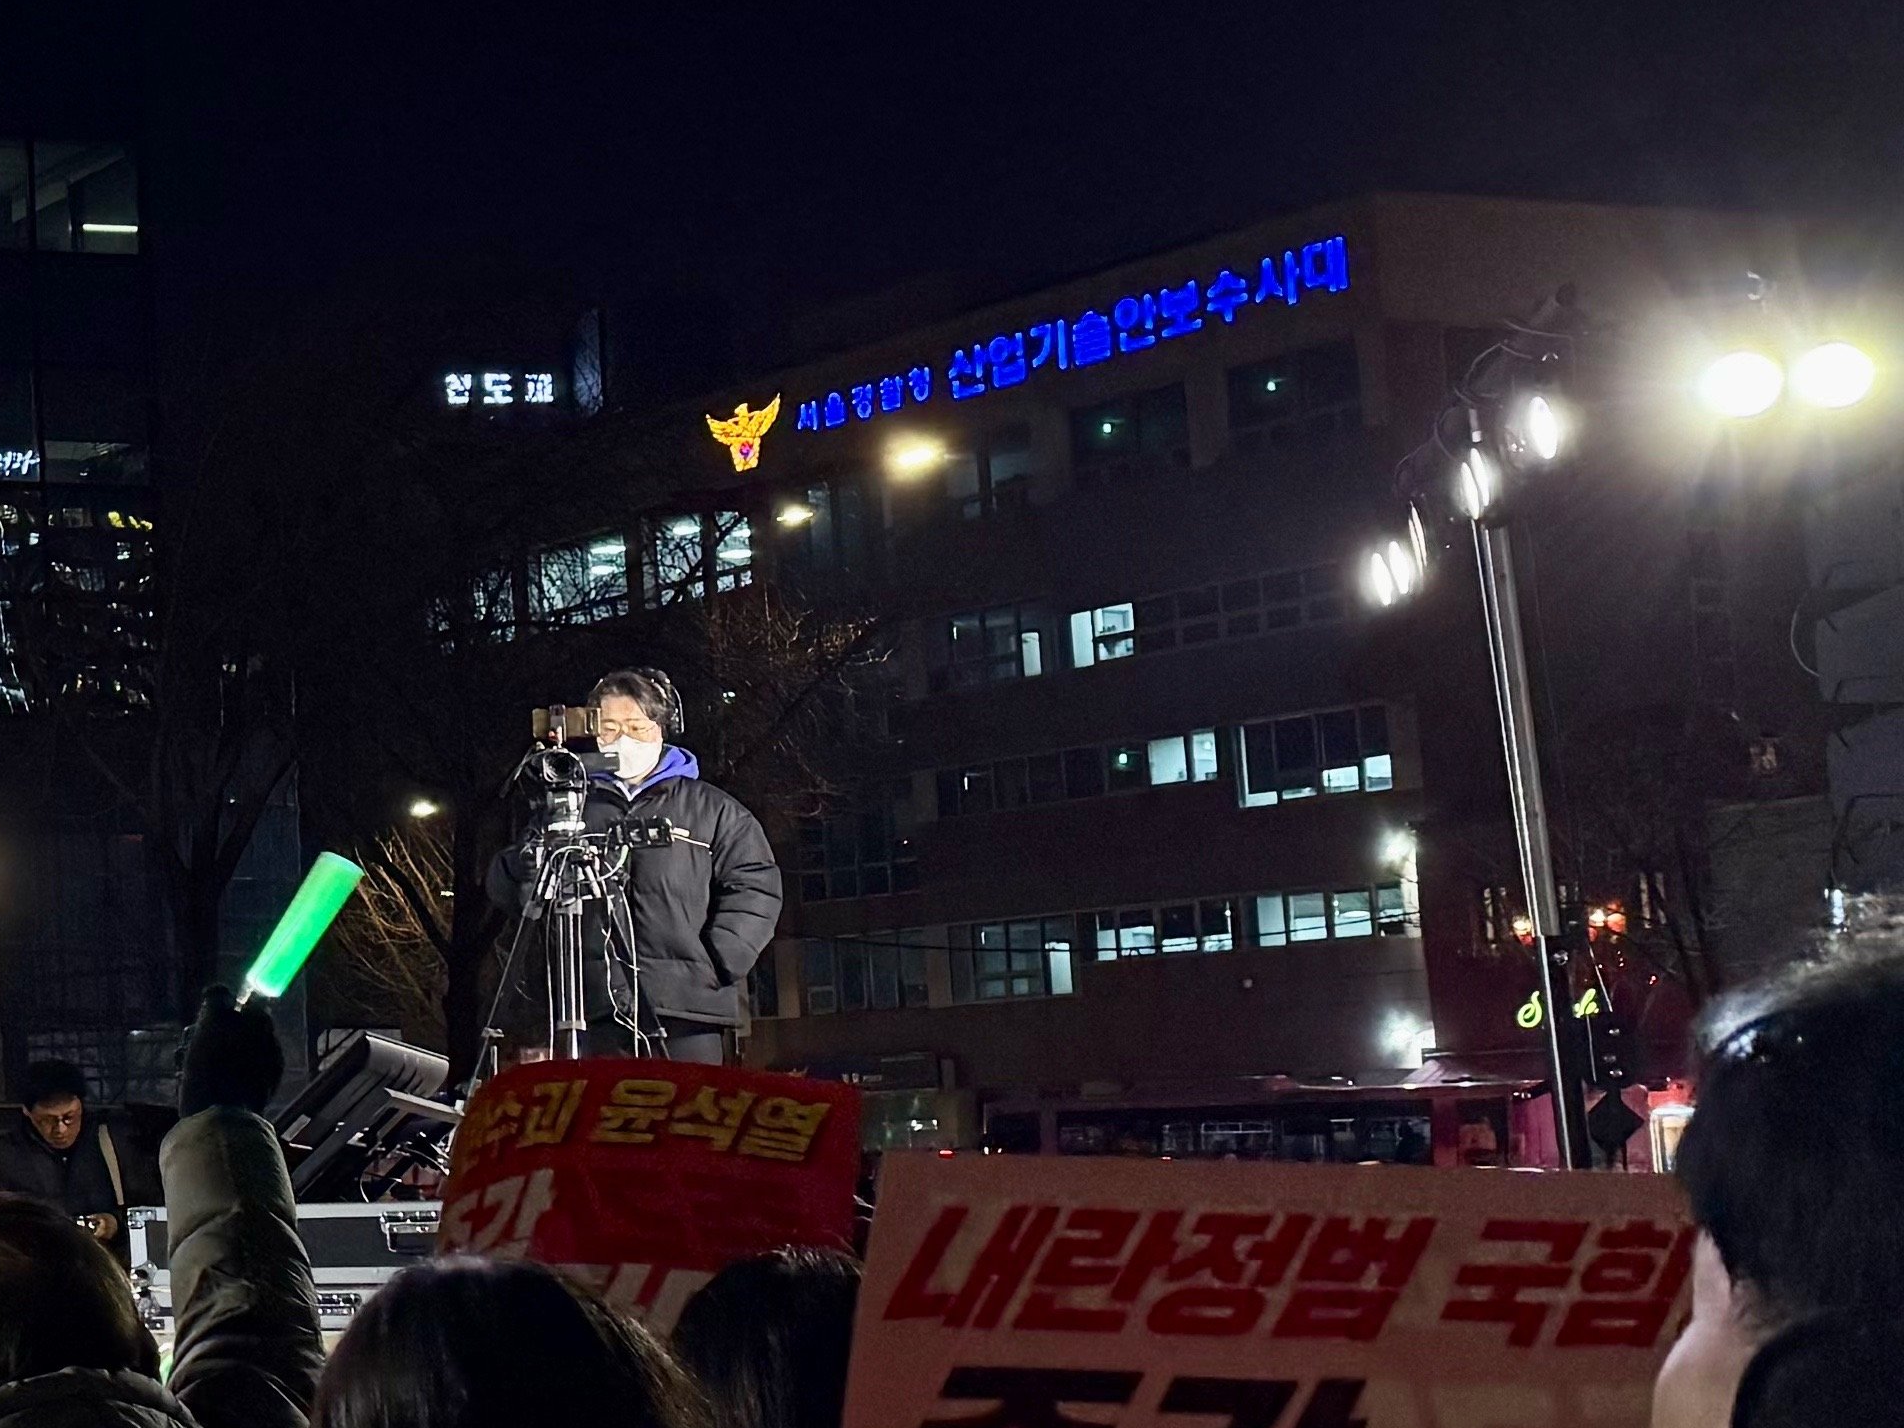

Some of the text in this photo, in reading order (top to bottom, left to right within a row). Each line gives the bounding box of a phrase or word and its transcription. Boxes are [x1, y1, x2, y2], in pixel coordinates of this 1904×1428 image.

[947, 234, 1350, 401] 산업기술안보수사대
[589, 1078, 833, 1163] 윤석열
[884, 1201, 1440, 1344] 내란정범
[1441, 1216, 1694, 1350] 국힘
